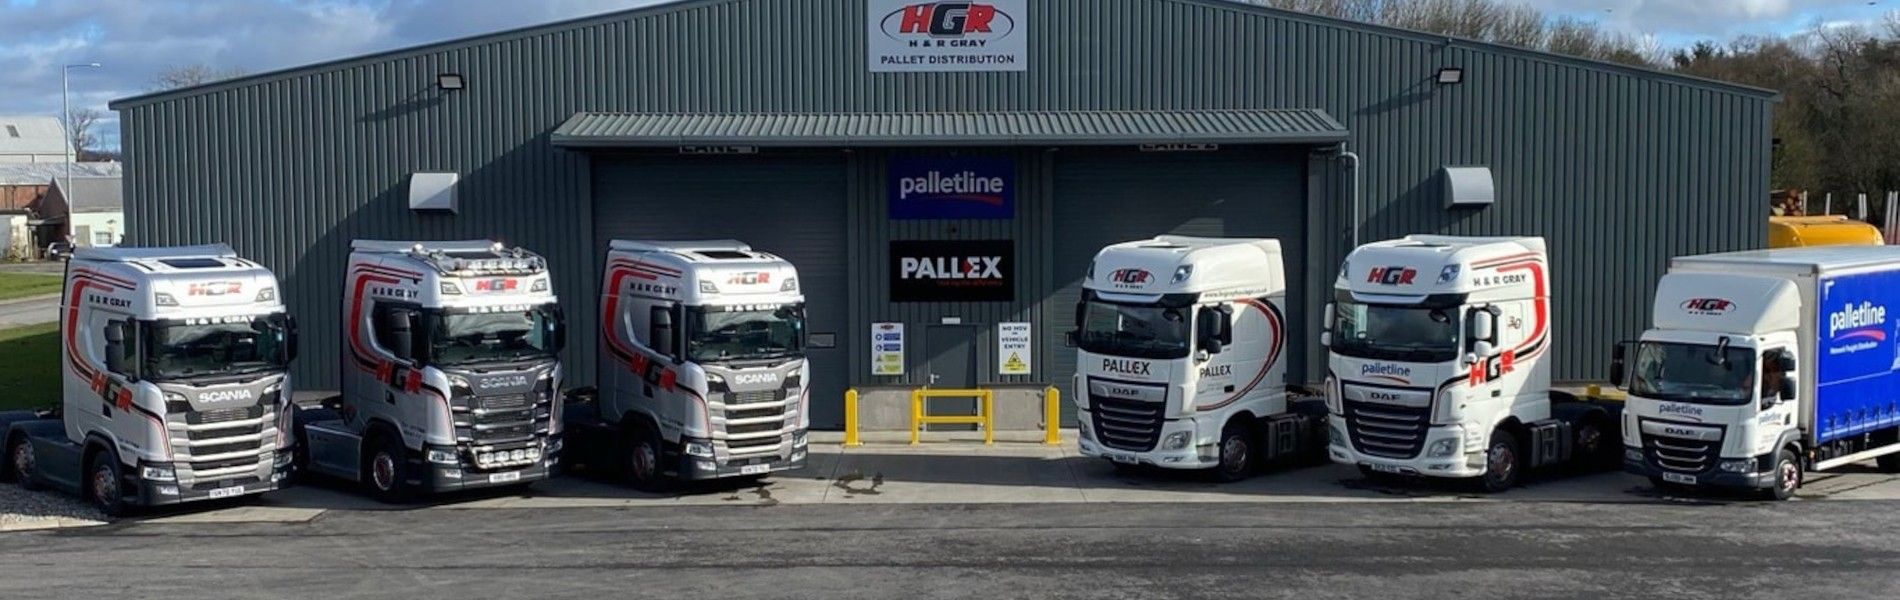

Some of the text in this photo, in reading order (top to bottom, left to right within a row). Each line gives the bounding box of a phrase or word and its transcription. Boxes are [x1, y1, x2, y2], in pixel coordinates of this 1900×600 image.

[900, 2, 995, 37] HGR
[881, 54, 1015, 64] PALLET DISTRIBUTION
[900, 171, 1004, 200] palletline
[901, 256, 1002, 279] PALLEX
[1114, 269, 1149, 283] HGR
[1367, 266, 1418, 286] HGR
[1474, 273, 1526, 286] H & R GRAY
[476, 279, 517, 290] HGR
[110, 297, 132, 308] GRAY
[223, 314, 256, 323] GRAY
[1829, 301, 1886, 338] palletline
[631, 352, 677, 393] HGR
[1103, 358, 1151, 375] PALLEX
[1199, 364, 1232, 378] PALLEX
[1361, 361, 1411, 376] palletline
[1469, 349, 1516, 388] HGR
[376, 358, 422, 394] HGR
[480, 376, 528, 388] SCANIA
[735, 373, 777, 385] SCANIA
[91, 369, 133, 412] HGR
[199, 389, 252, 403] SCANIA
[1111, 387, 1139, 395] DAF
[1369, 392, 1401, 401] DAF
[1659, 404, 1703, 416] palletline
[1664, 427, 1696, 435] DAF
